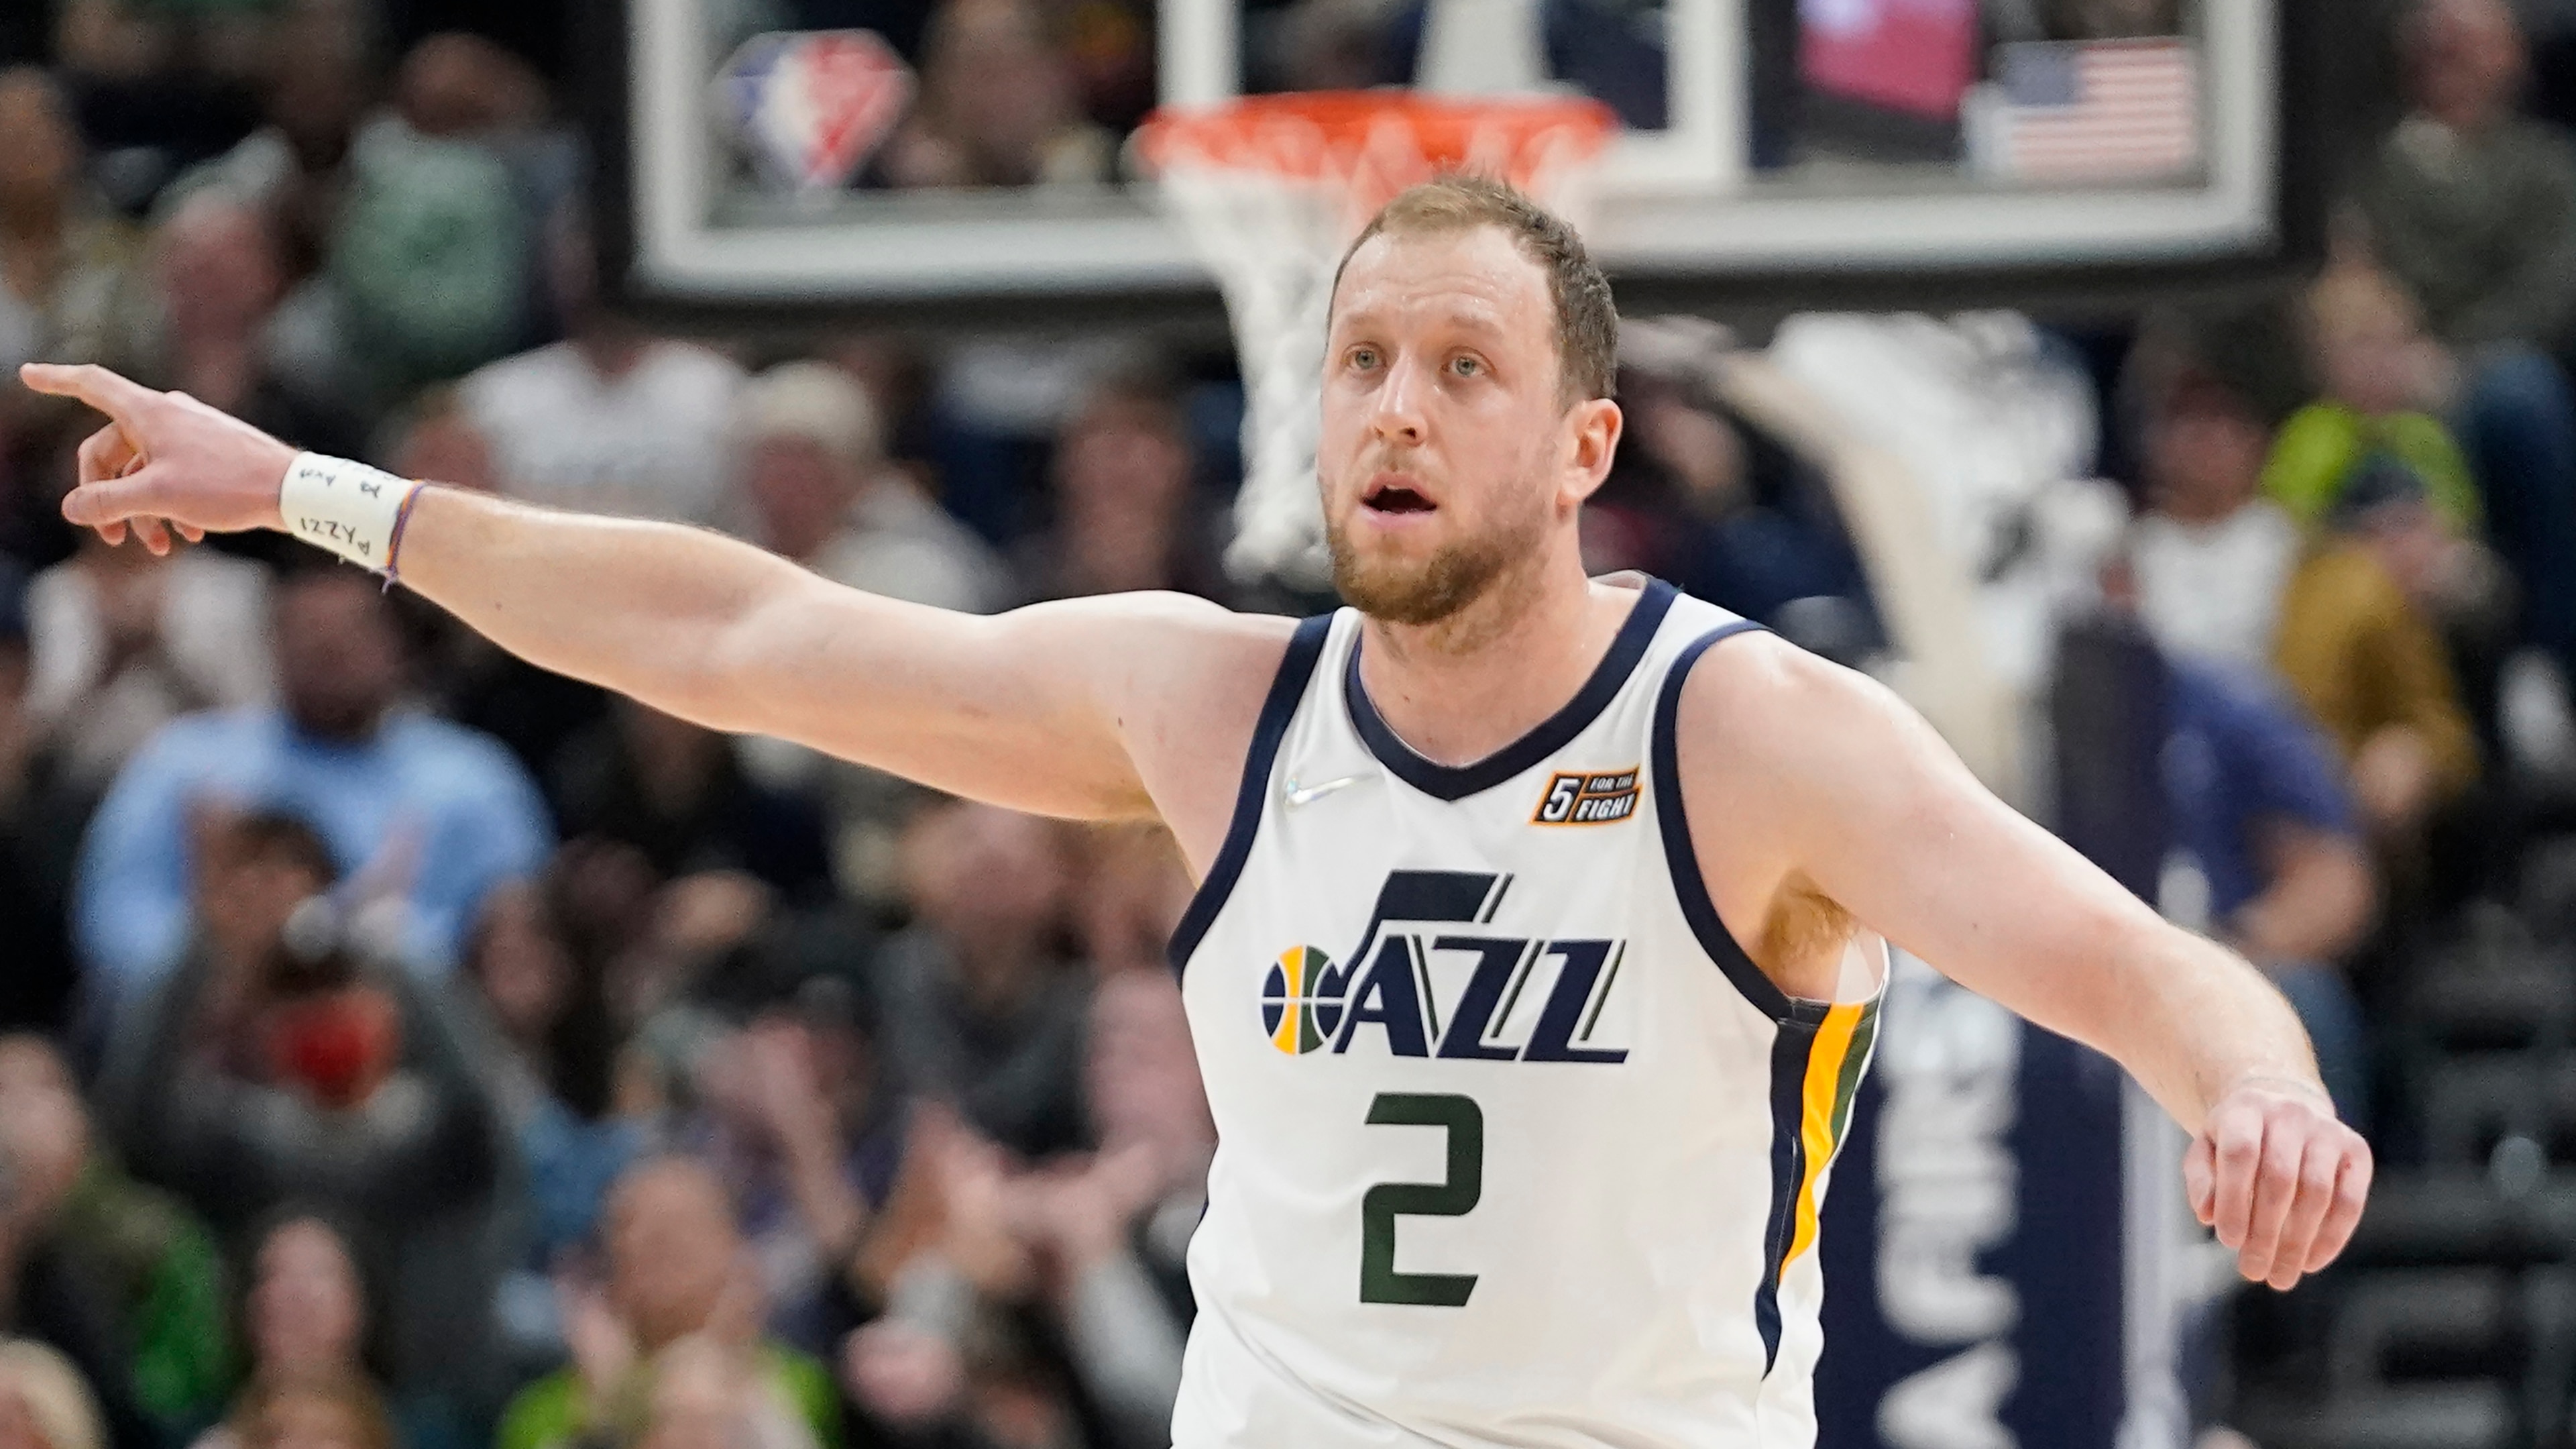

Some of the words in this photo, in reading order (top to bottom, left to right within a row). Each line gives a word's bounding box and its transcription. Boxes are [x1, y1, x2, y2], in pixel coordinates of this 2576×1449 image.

[1543, 777, 1581, 822] 5
[1589, 776, 1615, 793] FOR
[1616, 773, 1634, 790] THE
[1576, 793, 1636, 821] FIGHT
[1262, 869, 1630, 1064] JAZZ
[1360, 1092, 1483, 1307] 2
